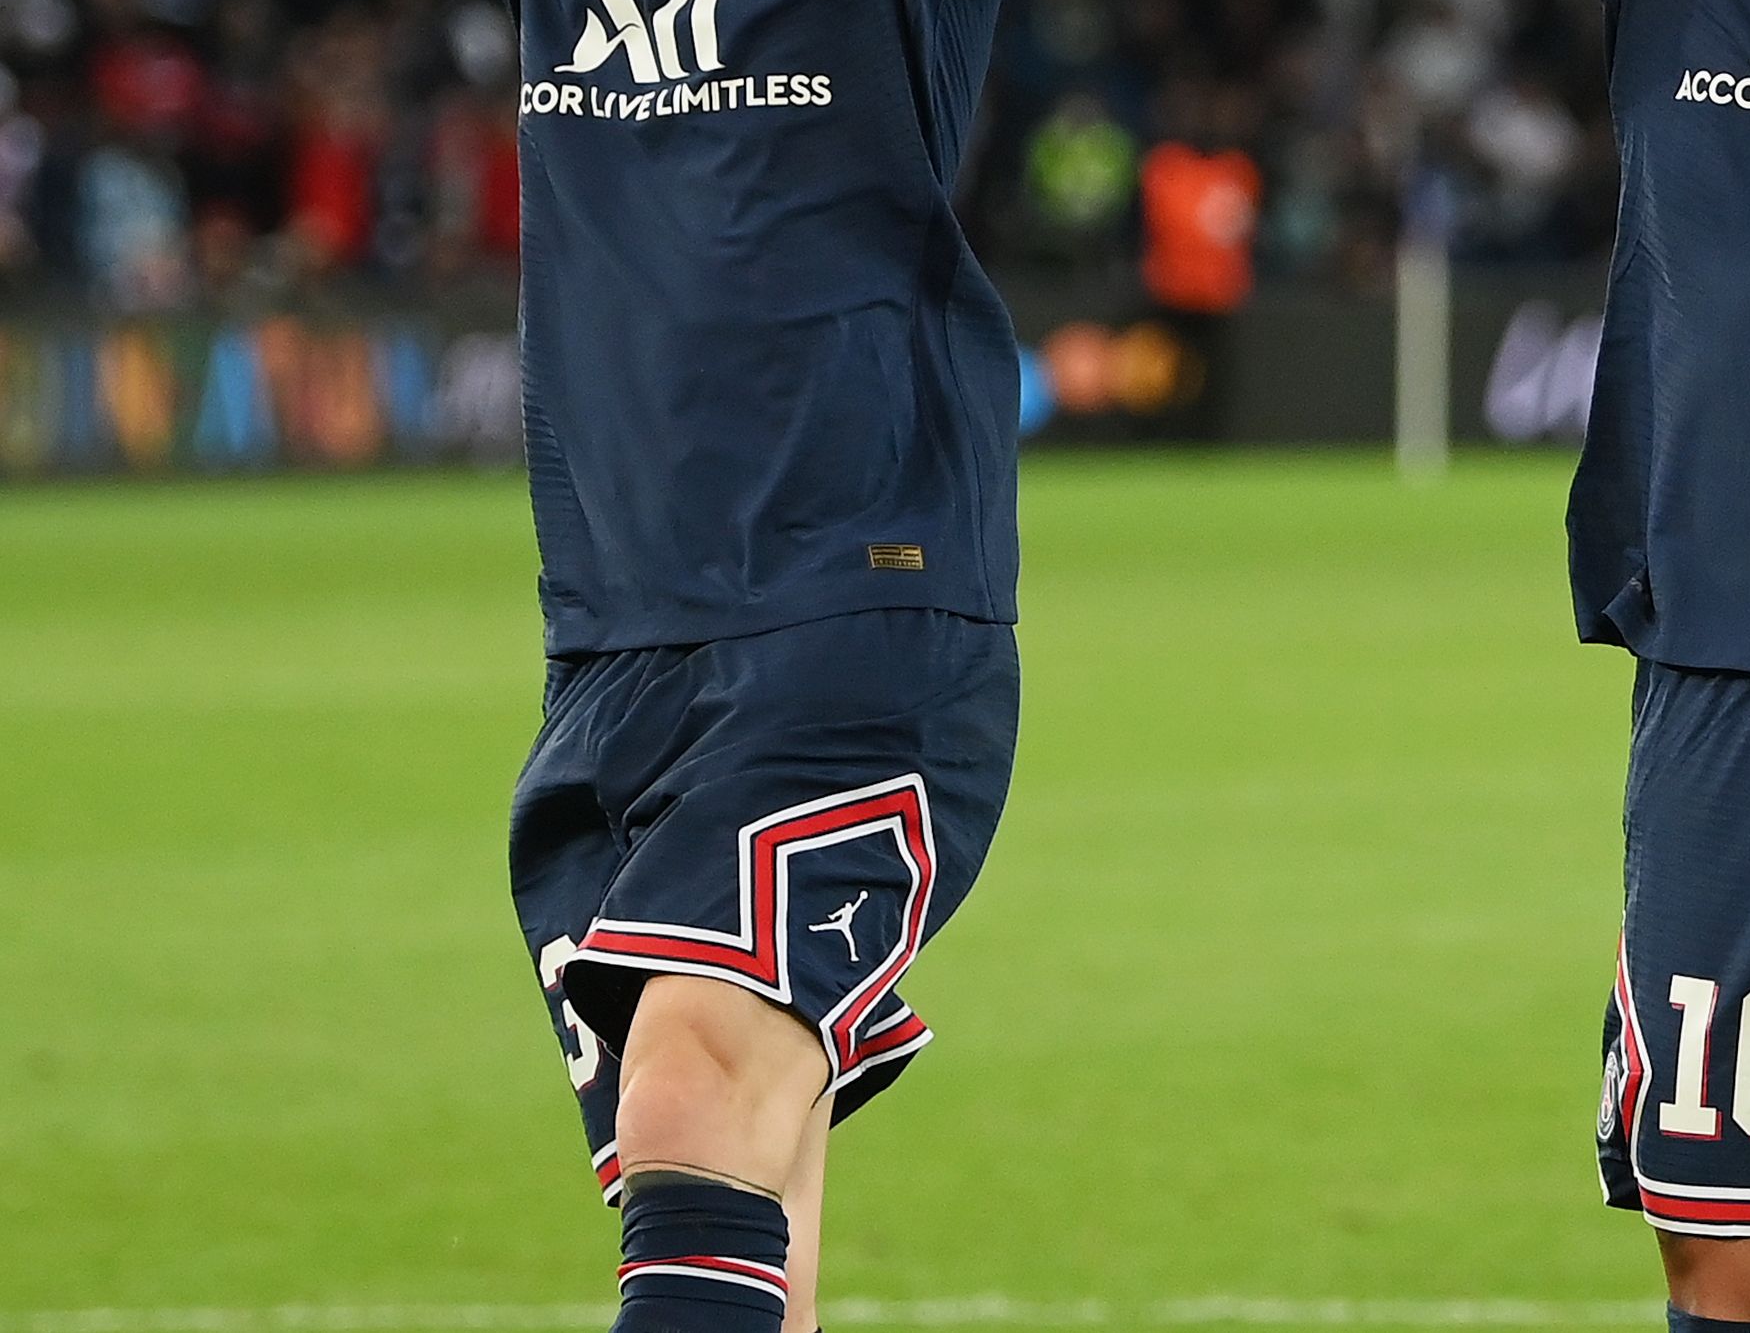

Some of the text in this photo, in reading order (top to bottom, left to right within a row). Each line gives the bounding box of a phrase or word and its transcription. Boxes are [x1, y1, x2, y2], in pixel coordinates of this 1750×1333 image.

[521, 74, 833, 121] COR LIVE LIMITLESS
